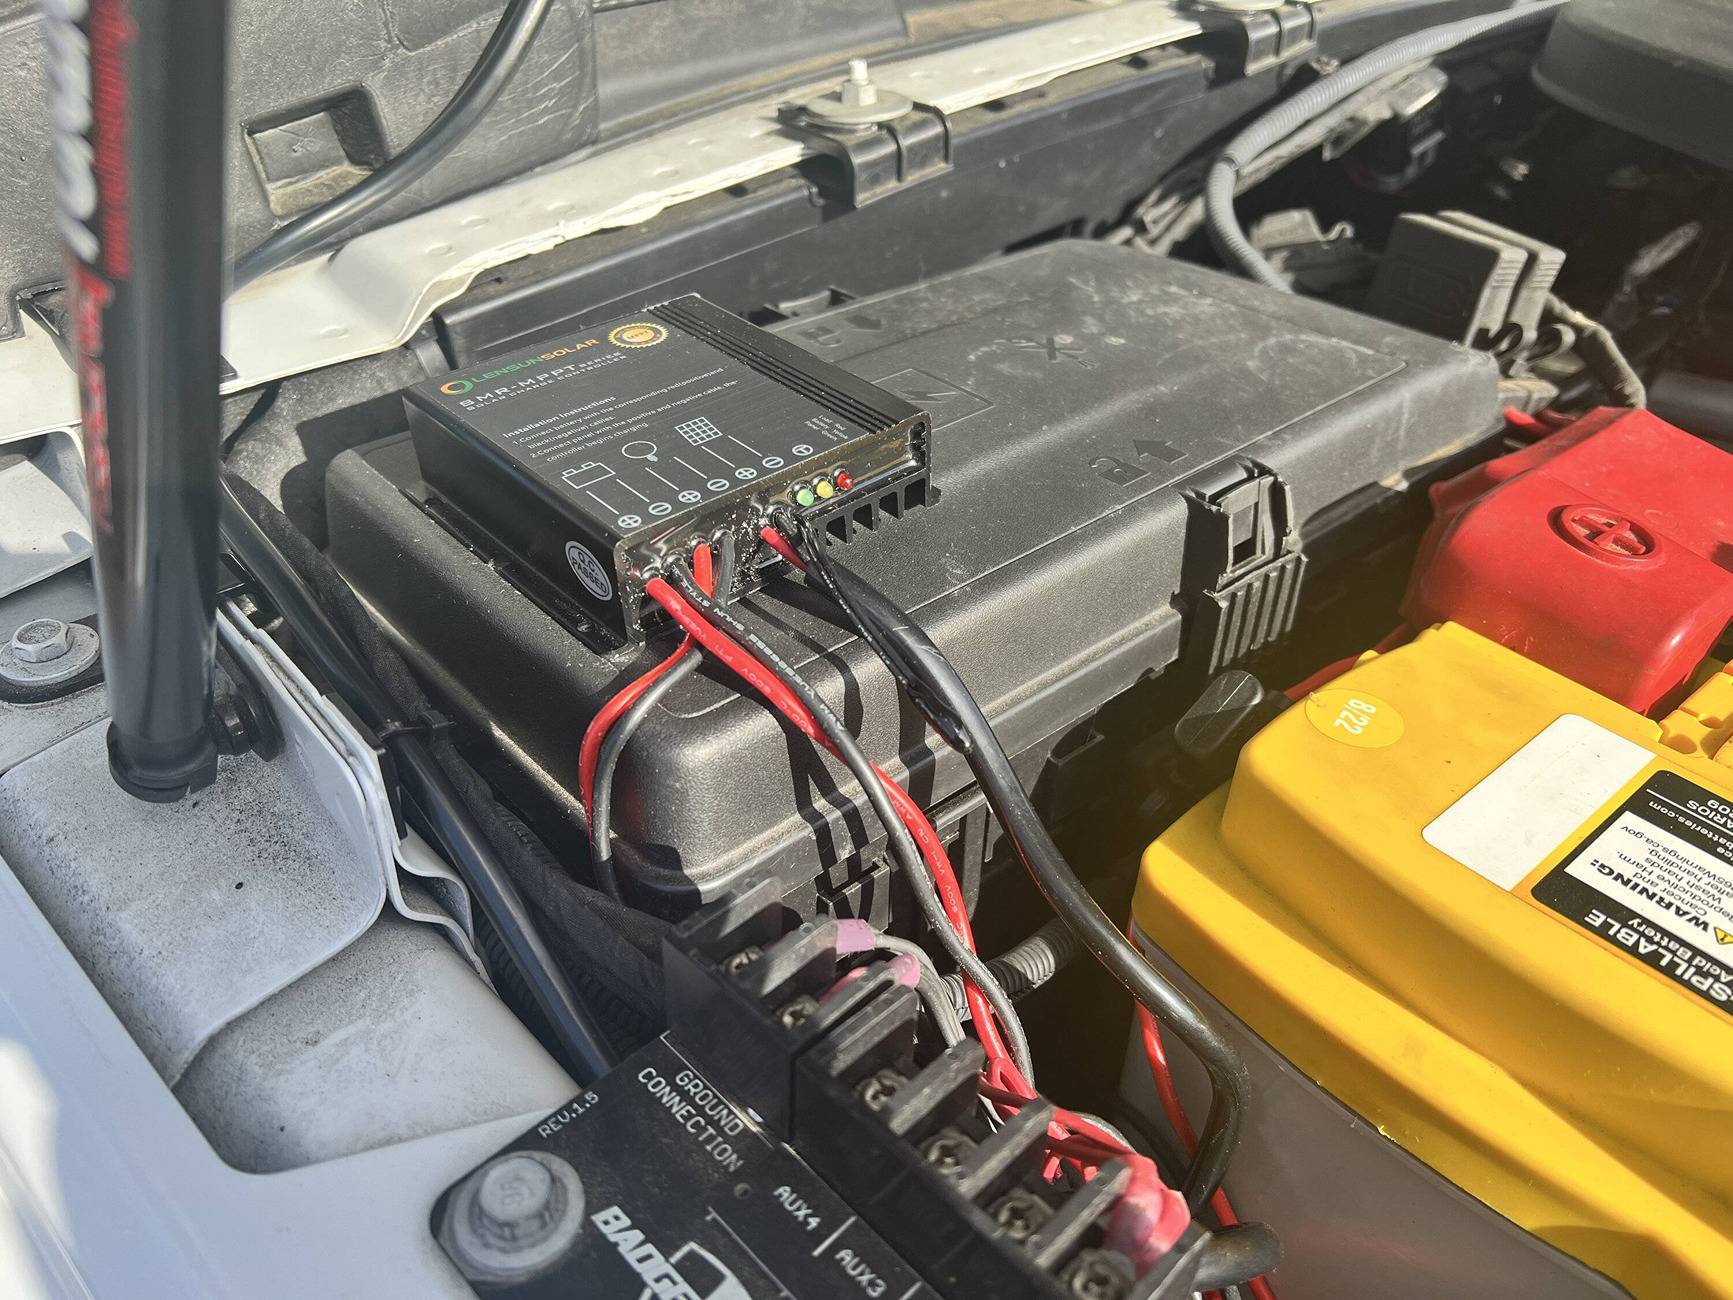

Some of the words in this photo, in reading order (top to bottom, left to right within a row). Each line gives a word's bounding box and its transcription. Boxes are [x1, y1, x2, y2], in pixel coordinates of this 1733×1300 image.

[471, 338, 600, 383] LENSUNSOLAR
[466, 394, 506, 411] SOLAR
[510, 379, 556, 398] CHARGE
[557, 355, 628, 381] CONTROLLER
[503, 416, 560, 439] Installation
[559, 396, 617, 419] Instructions
[553, 417, 583, 433] battery
[582, 411, 601, 421] with
[600, 406, 615, 415] the
[614, 388, 669, 410] corresponding
[573, 431, 596, 445] panel
[595, 424, 612, 435] with
[612, 419, 627, 428] the
[626, 409, 657, 424] positive
[656, 403, 672, 413] and
[671, 393, 703, 408] negative
[527, 425, 590, 450] black(negative)
[546, 444, 586, 463] controller
[585, 433, 615, 448] begins
[613, 421, 649, 438] charging
[571, 556, 607, 594] PASSED
[1332, 698, 1378, 735] 8/22
[1616, 850, 1654, 877] Harm.
[1632, 871, 1659, 888] and
[1644, 856, 1684, 883] hands
[1647, 847, 1703, 884] handling.
[1589, 858, 1710, 933] WARNING:
[1659, 886, 1708, 917] Cancer
[1686, 879, 1722, 905] Wash
[1627, 917, 1693, 961] Battery
[1691, 955, 1733, 983] Acid
[536, 1090, 600, 1140] REV.1.5
[636, 1066, 744, 1173] CONNECTION
[674, 1069, 746, 1138] GROUND
[772, 1184, 822, 1232] AUX4
[833, 1247, 888, 1299] AUX3
